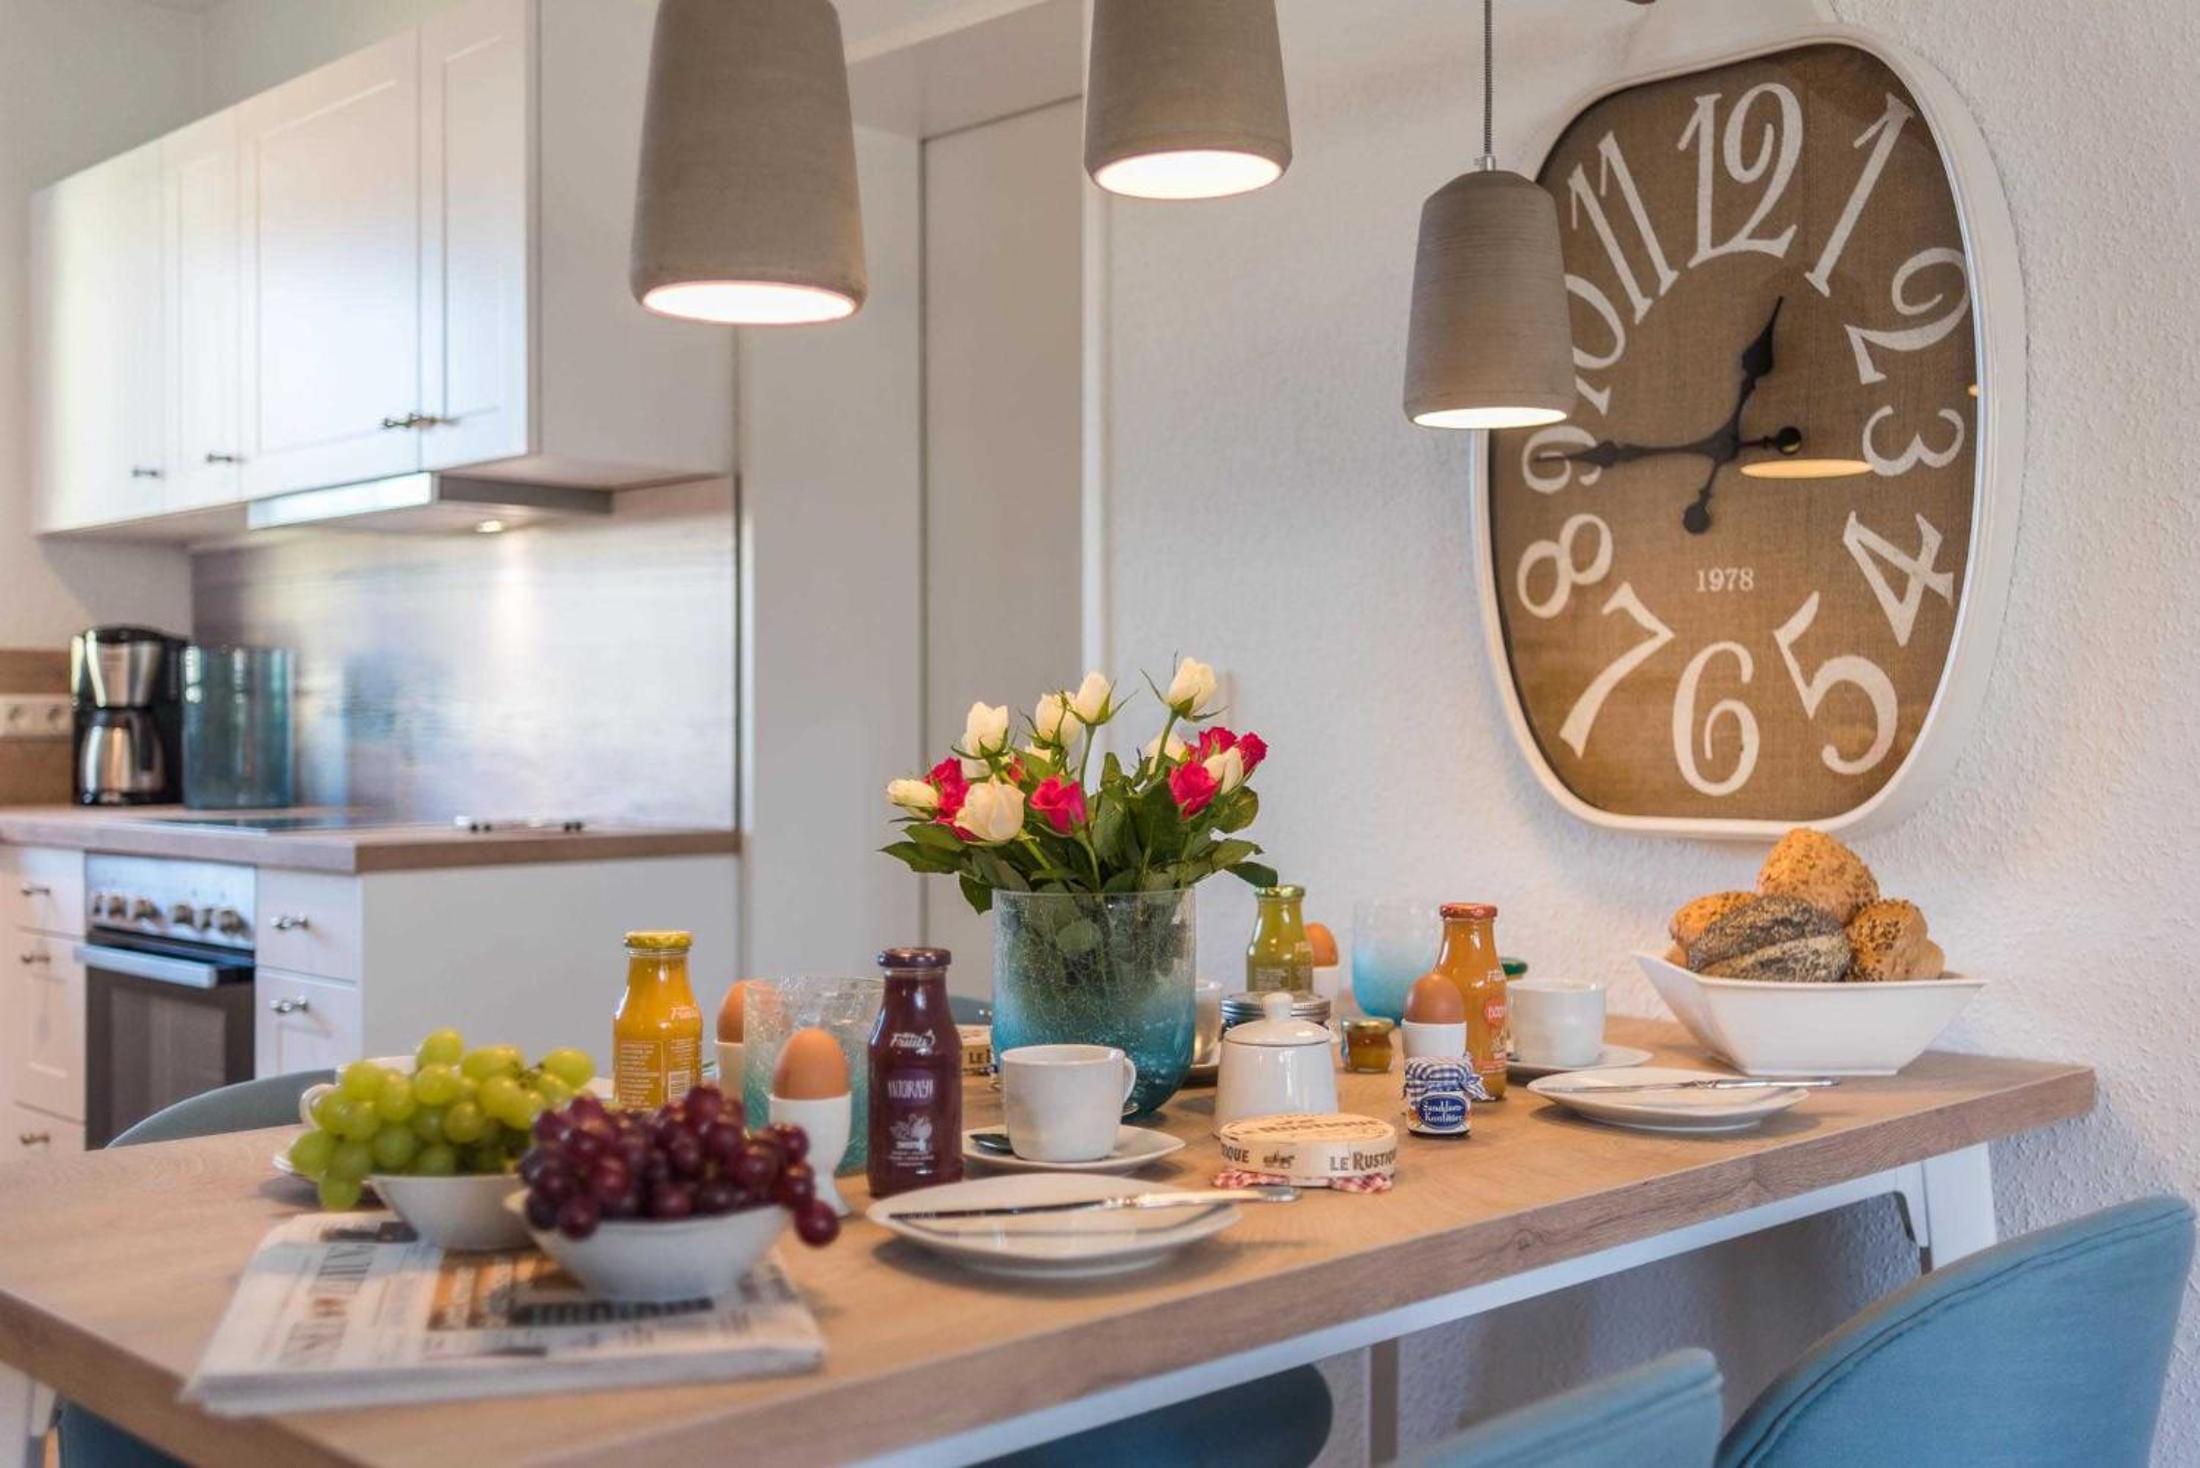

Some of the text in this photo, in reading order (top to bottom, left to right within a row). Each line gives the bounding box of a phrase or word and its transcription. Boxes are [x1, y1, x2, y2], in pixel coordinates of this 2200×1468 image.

[1568, 131, 1679, 325] 11
[1678, 82, 1803, 269] 12
[1805, 92, 1915, 297] 1
[1844, 246, 1975, 385] 2
[1521, 424, 1602, 495] 9
[1862, 404, 1965, 477] 3
[1516, 512, 1613, 618] 8
[1696, 567, 1755, 593] 1978
[1842, 510, 1954, 647] 4
[1558, 582, 1676, 759] 7
[1672, 640, 1760, 797] 6
[1774, 591, 1898, 776] 5
[1330, 1156, 1349, 1171] LE
